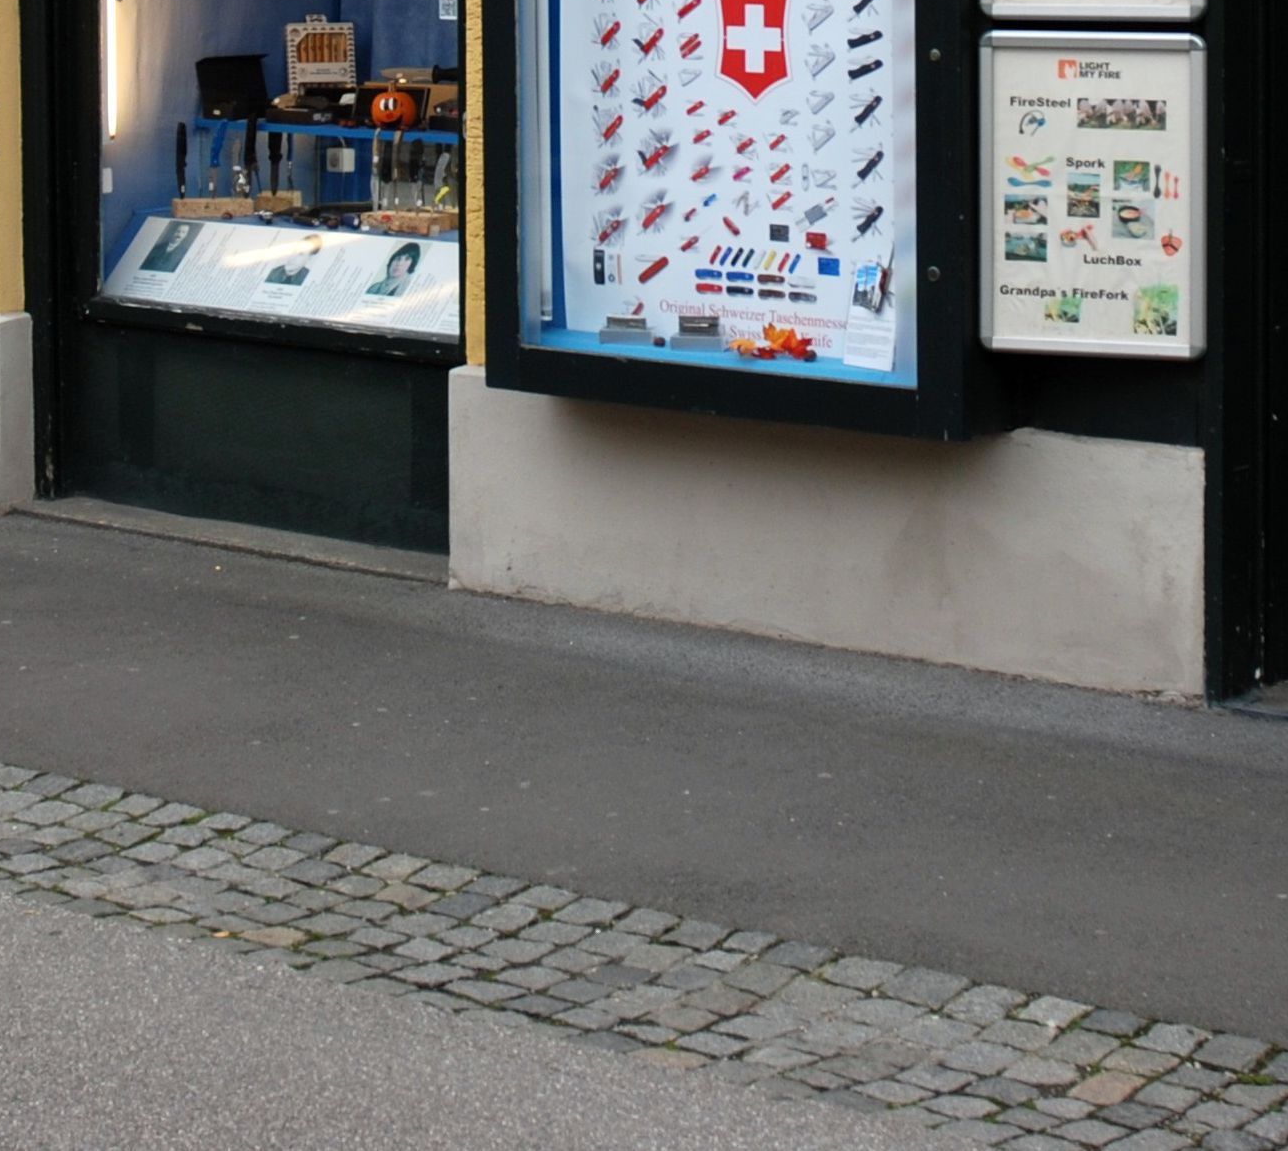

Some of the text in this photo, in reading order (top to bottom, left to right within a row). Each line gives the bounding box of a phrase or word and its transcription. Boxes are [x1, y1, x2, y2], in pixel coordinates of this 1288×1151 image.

[1079, 62, 1110, 71] LIGHT
[1079, 71, 1121, 80] MY FIRE
[1010, 96, 1071, 109] FireSteel
[1066, 157, 1105, 169] Spork
[1083, 254, 1142, 267] LuchBox
[1072, 288, 1129, 301] FireFork
[708, 304, 766, 323] Schweizer
